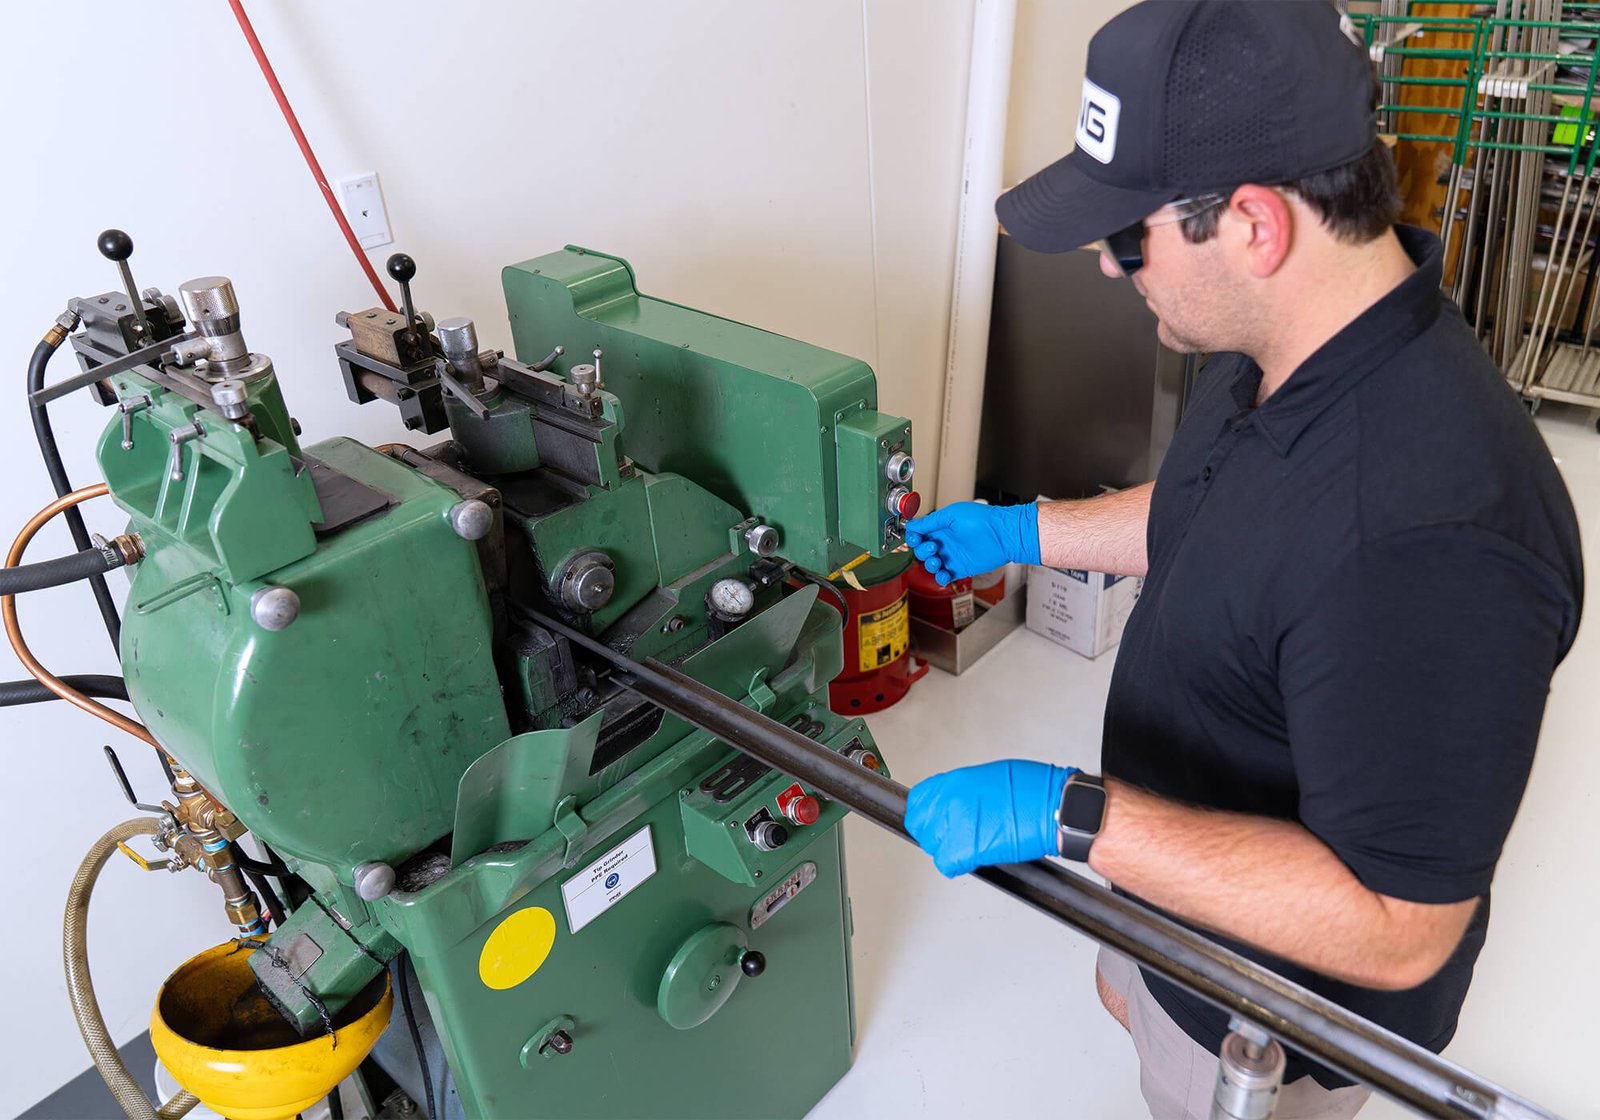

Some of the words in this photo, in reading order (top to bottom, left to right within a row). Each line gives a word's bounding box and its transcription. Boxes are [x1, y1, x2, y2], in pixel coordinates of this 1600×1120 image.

[751, 813, 762, 824] START
[603, 851, 623, 866] Grinder
[591, 872, 602, 882] PPE
[603, 854, 628, 873] Required
